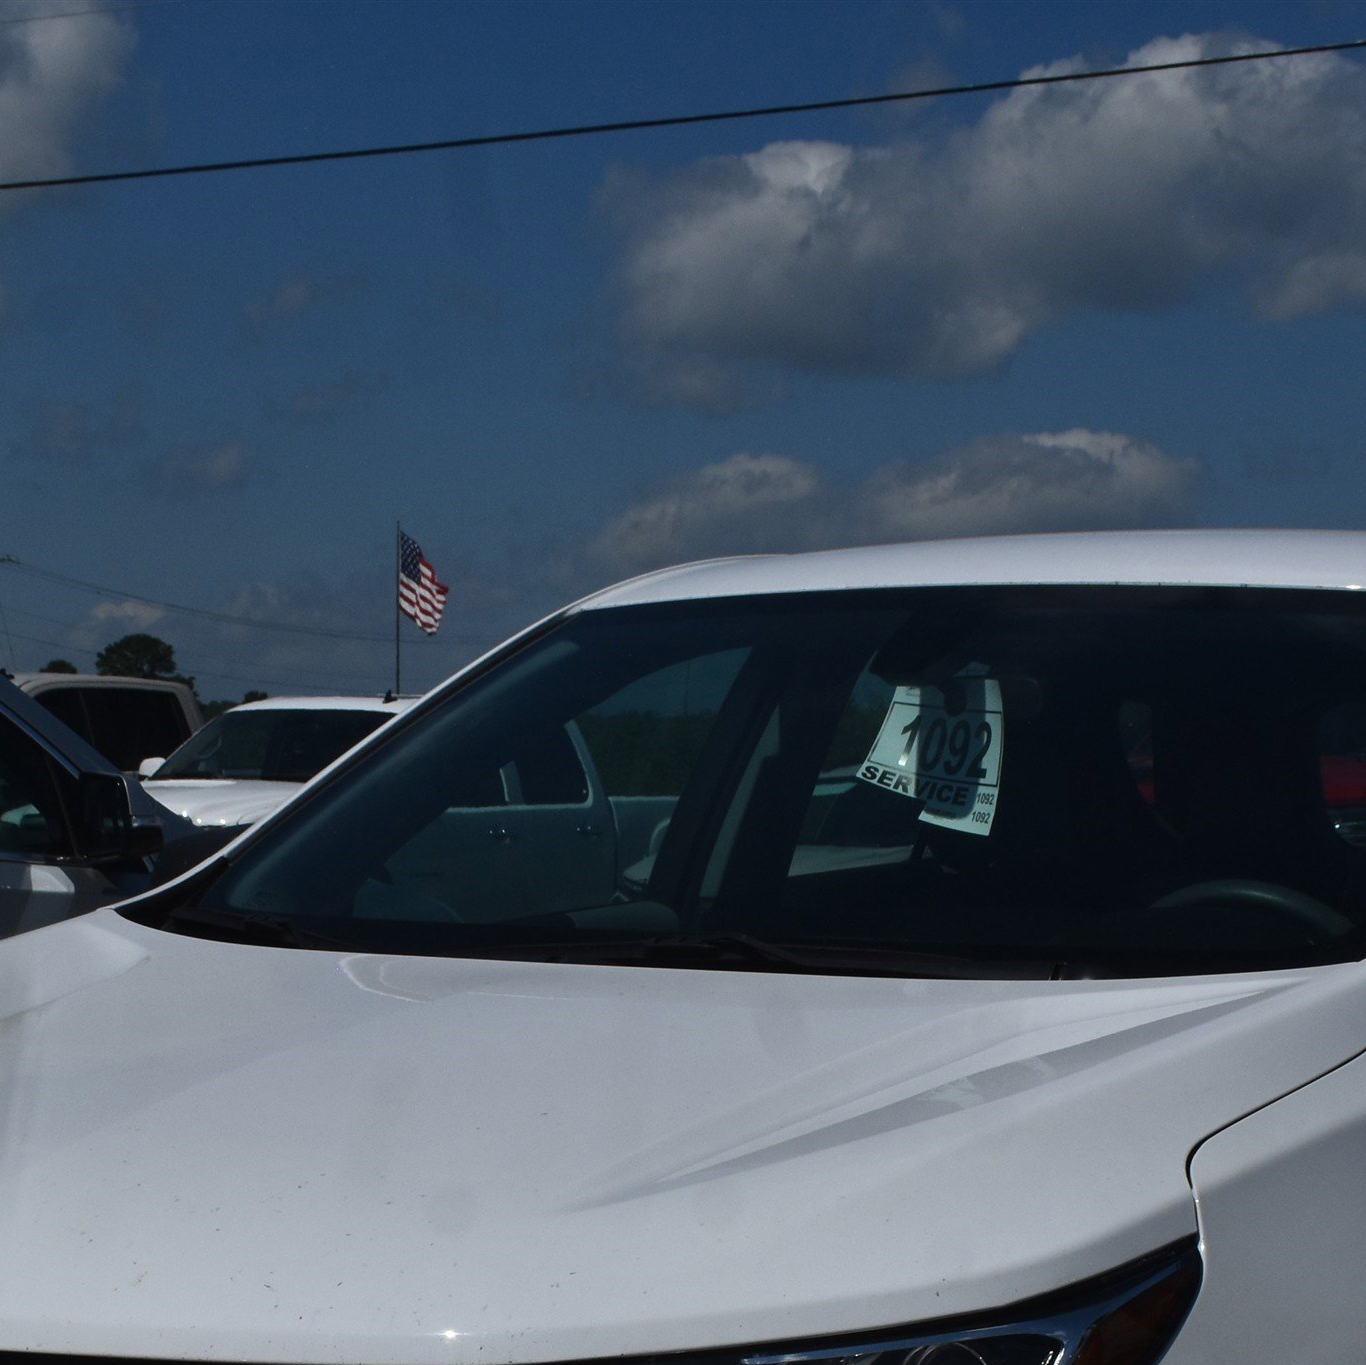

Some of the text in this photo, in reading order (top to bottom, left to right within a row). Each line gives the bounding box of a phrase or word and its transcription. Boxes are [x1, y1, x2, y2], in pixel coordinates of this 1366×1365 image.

[897, 714, 992, 779] 1092
[861, 765, 969, 806] SERVICE
[977, 792, 995, 806] 1092
[971, 811, 991, 825] 1092
